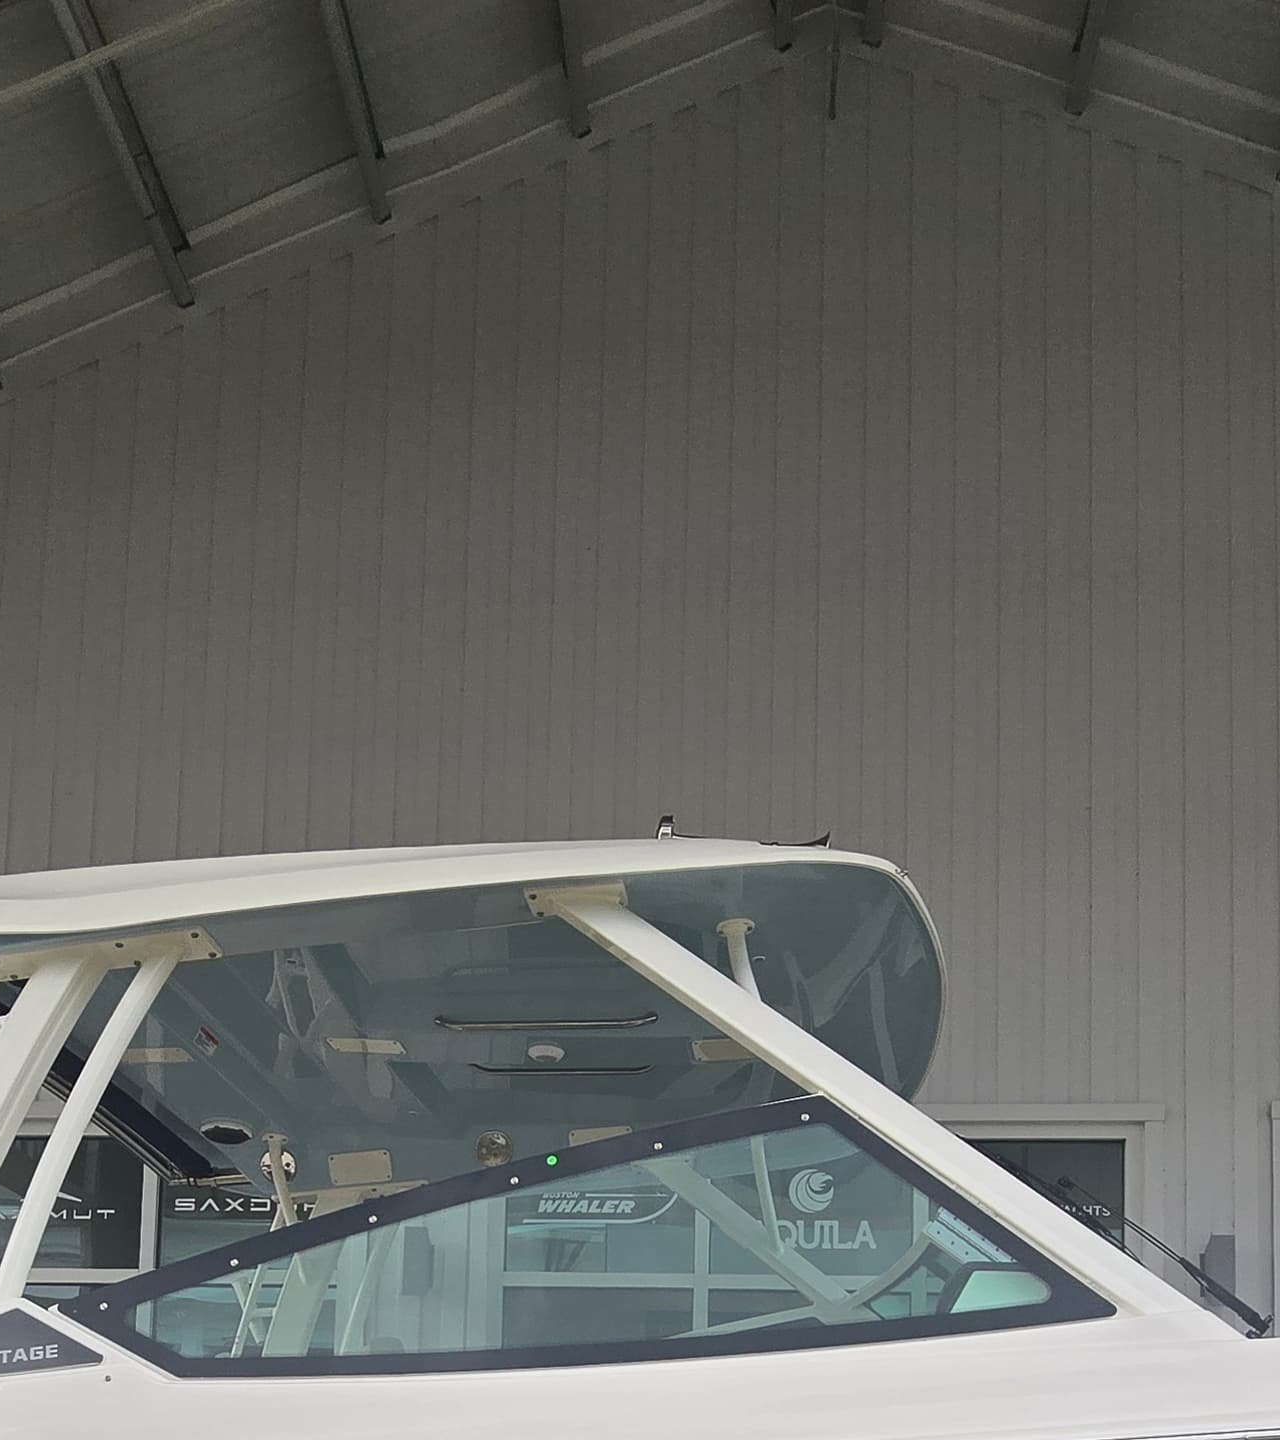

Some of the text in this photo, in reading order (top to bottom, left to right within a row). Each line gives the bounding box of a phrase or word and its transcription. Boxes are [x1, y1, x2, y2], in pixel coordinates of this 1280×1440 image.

[542, 1191, 580, 1199] BOSTON
[537, 1200, 636, 1214] WHALER
[756, 1219, 877, 1250] QUILA
